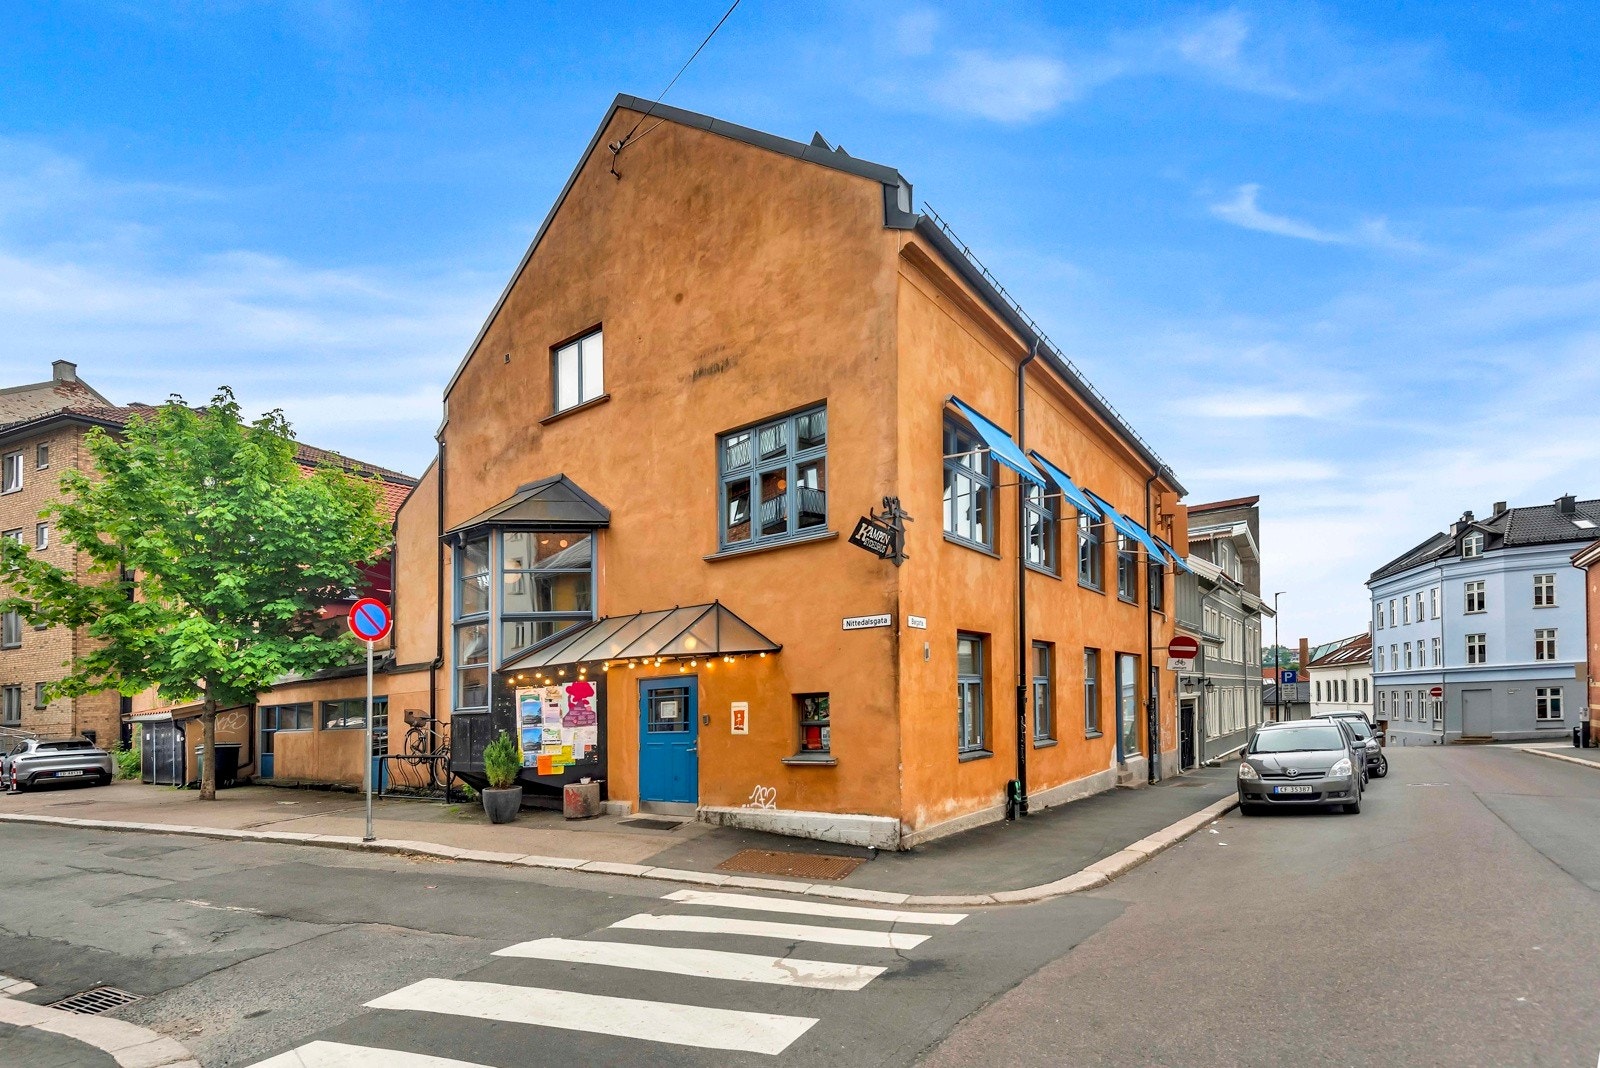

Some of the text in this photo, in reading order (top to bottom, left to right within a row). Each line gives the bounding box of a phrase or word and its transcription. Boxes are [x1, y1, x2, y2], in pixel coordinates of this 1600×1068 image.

[855, 523, 890, 545] KAMPEN
[846, 617, 888, 627] Nittedalsgata
[1284, 671, 1293, 683] P
